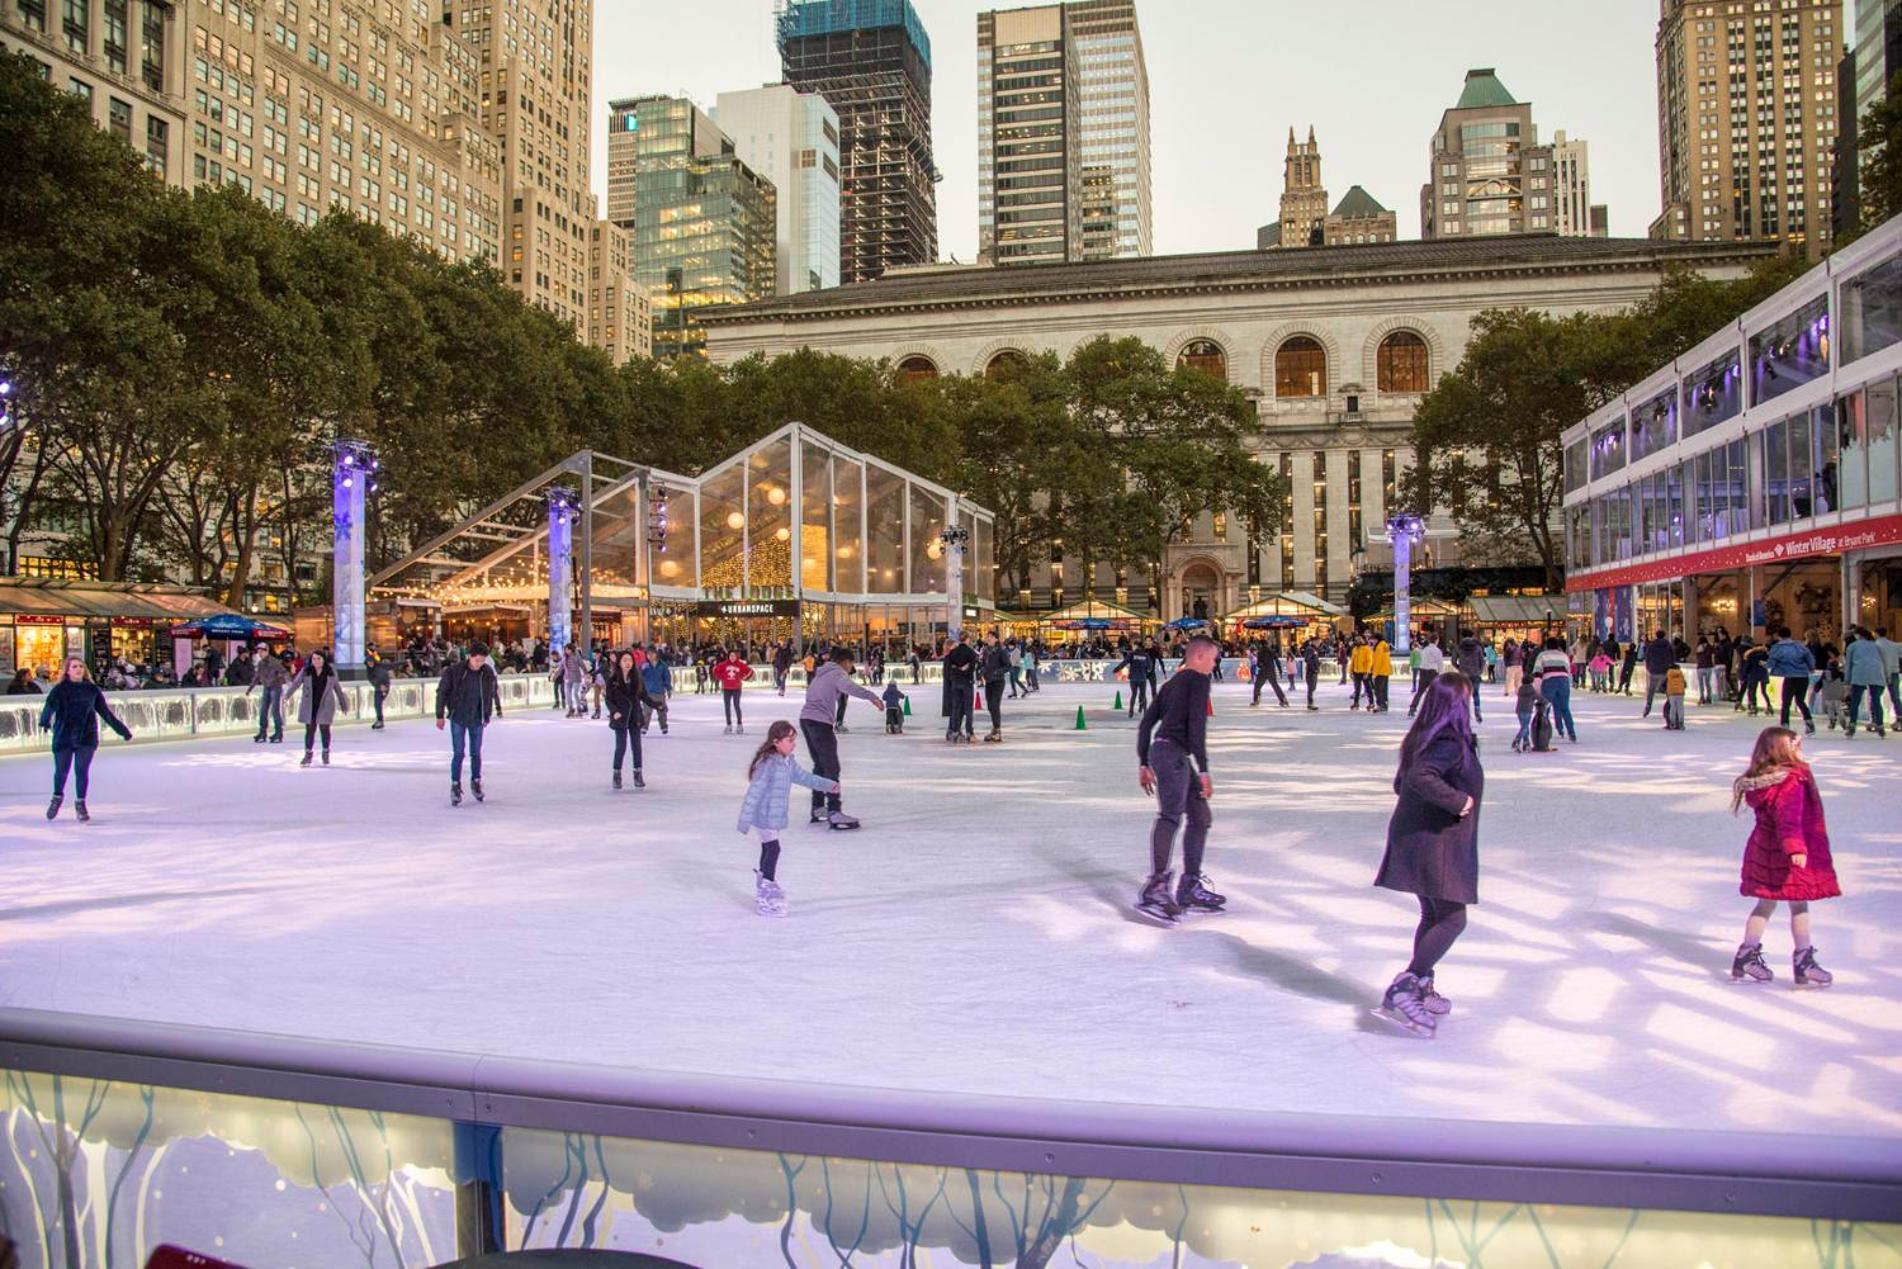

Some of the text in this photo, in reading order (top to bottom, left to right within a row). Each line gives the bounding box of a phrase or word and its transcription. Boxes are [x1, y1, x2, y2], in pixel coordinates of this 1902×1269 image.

[1786, 541, 1809, 556] Winter
[1809, 536, 1836, 553] Village
[727, 604, 774, 614] URBANSPACE
